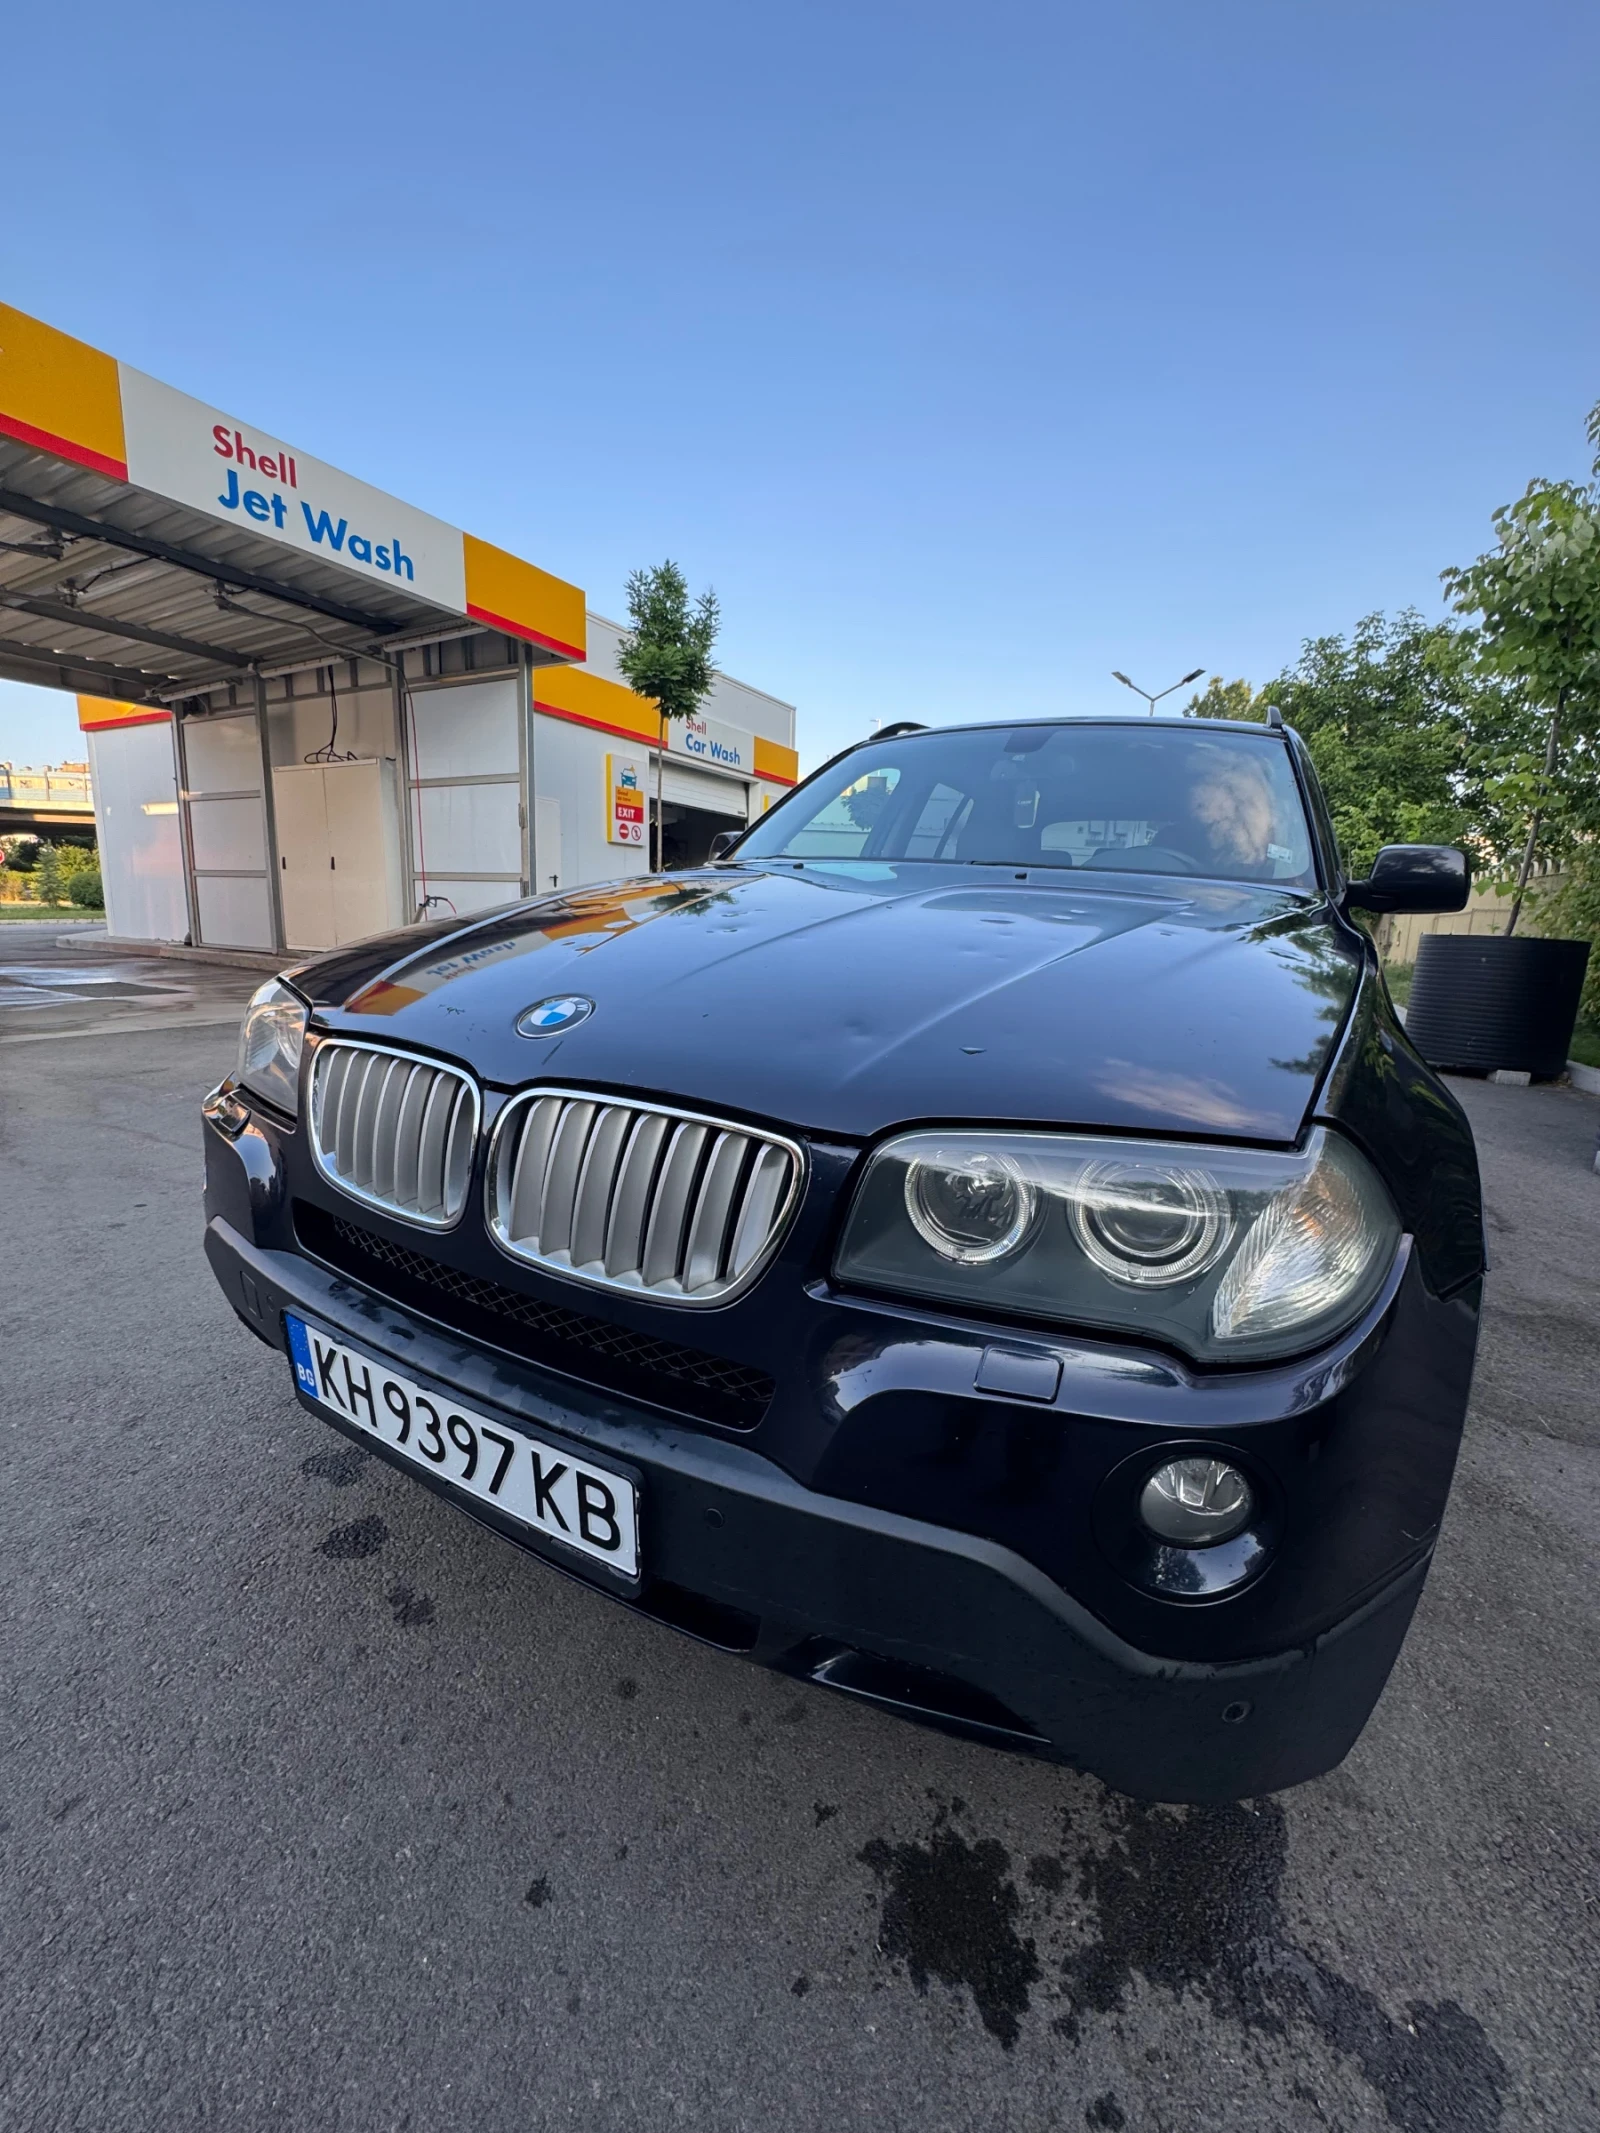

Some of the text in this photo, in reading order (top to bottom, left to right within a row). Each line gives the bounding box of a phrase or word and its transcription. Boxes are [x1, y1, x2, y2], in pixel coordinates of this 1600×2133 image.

[213, 425, 297, 489] Shell
[218, 469, 414, 581] Jet Wash
[686, 719, 706, 735] Shell
[686, 733, 740, 765] Car Wash
[617, 806, 635, 819] EXIT
[297, 1362, 315, 1387] BG
